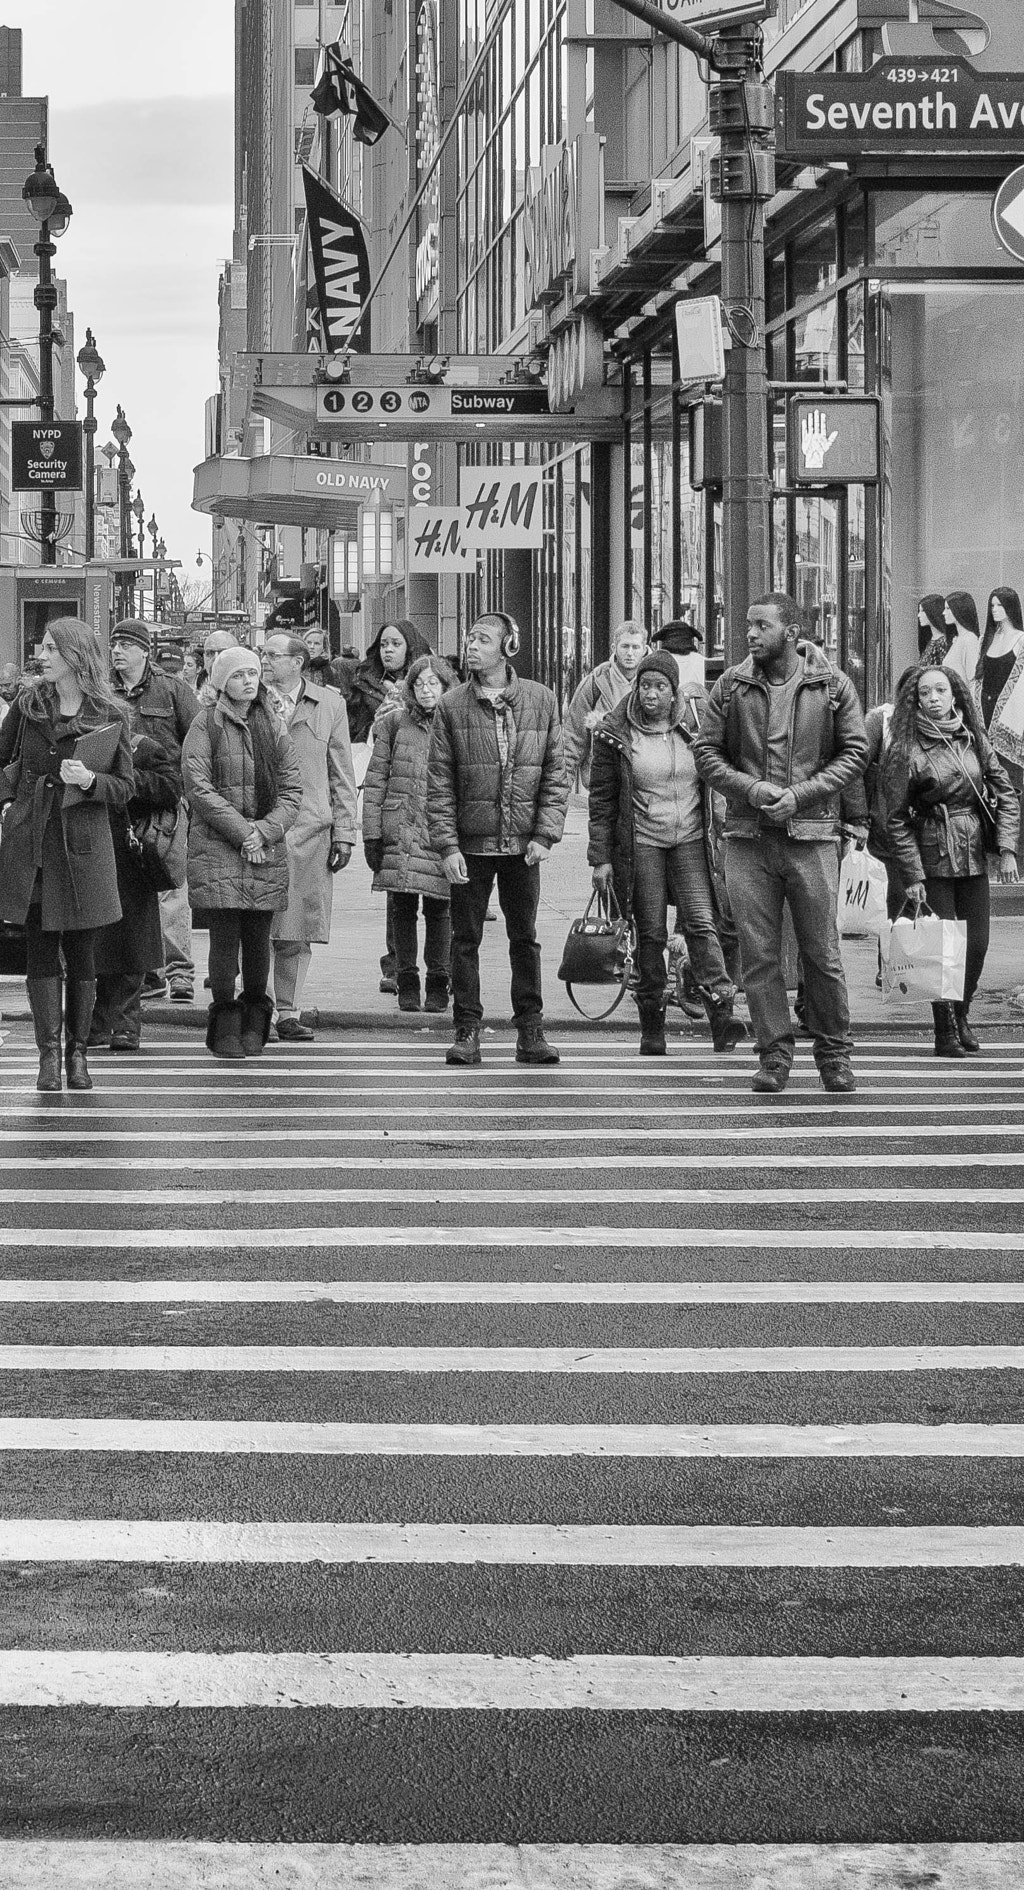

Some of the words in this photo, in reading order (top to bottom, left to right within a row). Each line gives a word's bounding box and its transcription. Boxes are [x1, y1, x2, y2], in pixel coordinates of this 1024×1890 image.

[887, 68, 916, 83] 439
[930, 68, 958, 83] 421
[806, 91, 957, 130] Seventh
[969, 93, 1024, 130] Av
[319, 217, 361, 336] NAVY
[356, 394, 369, 410] 2
[385, 394, 397, 410] 3
[408, 394, 428, 410] MTA
[452, 395, 515, 411] Subway
[32, 429, 62, 439] NYPD
[27, 459, 67, 470] Security
[28, 470, 66, 479] Camera
[316, 471, 346, 487] OLD
[348, 474, 390, 490] NAVY
[465, 481, 539, 530] H&M
[93, 584, 102, 636] Newsstand
